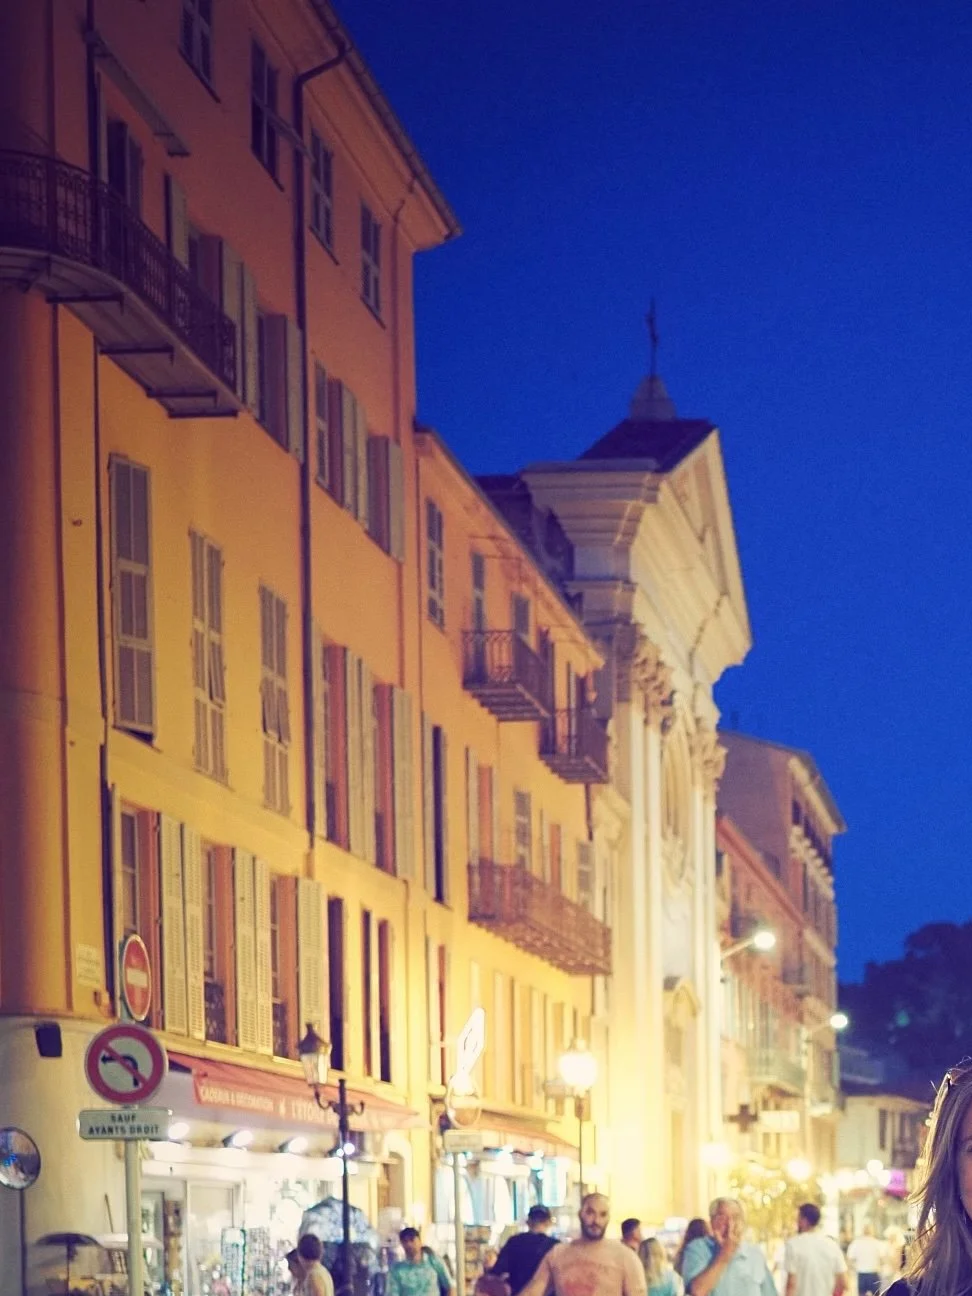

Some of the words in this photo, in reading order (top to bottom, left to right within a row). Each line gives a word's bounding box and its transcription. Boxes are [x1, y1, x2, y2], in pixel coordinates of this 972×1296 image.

[111, 1113, 136, 1122] SAUF
[88, 1125, 126, 1135] AYANTS
[129, 1124, 159, 1134] DROIT
